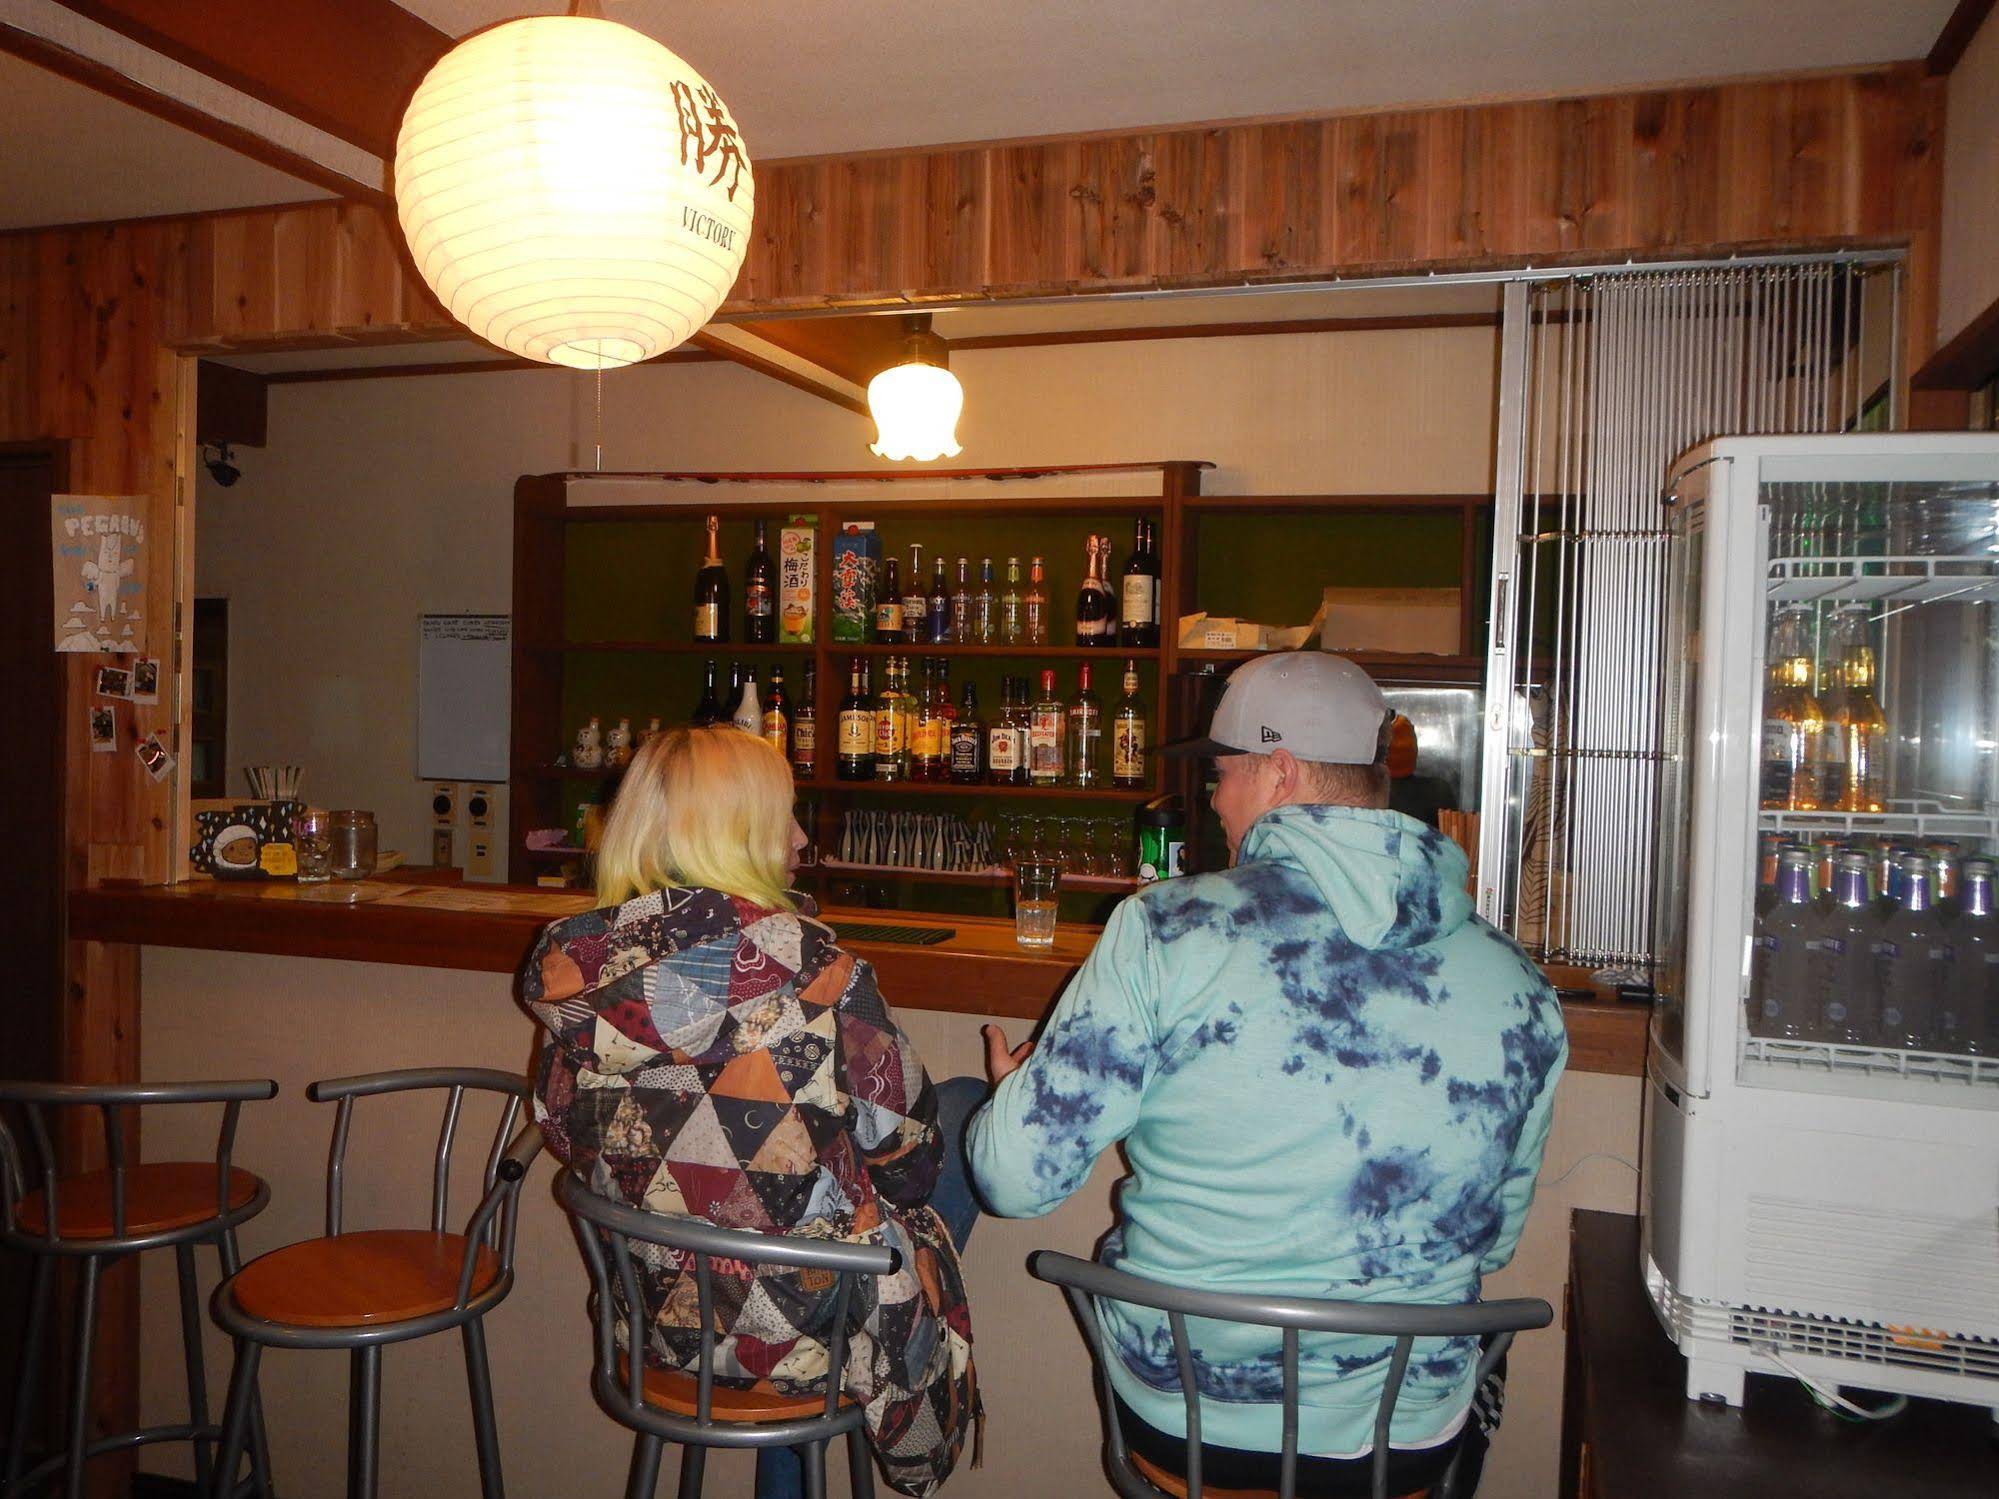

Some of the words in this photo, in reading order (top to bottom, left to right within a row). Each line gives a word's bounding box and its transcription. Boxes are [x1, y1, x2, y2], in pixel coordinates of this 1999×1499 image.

[669, 79, 748, 203] 勝
[681, 206, 737, 251] VICTORY
[783, 558, 799, 588] 梅酒
